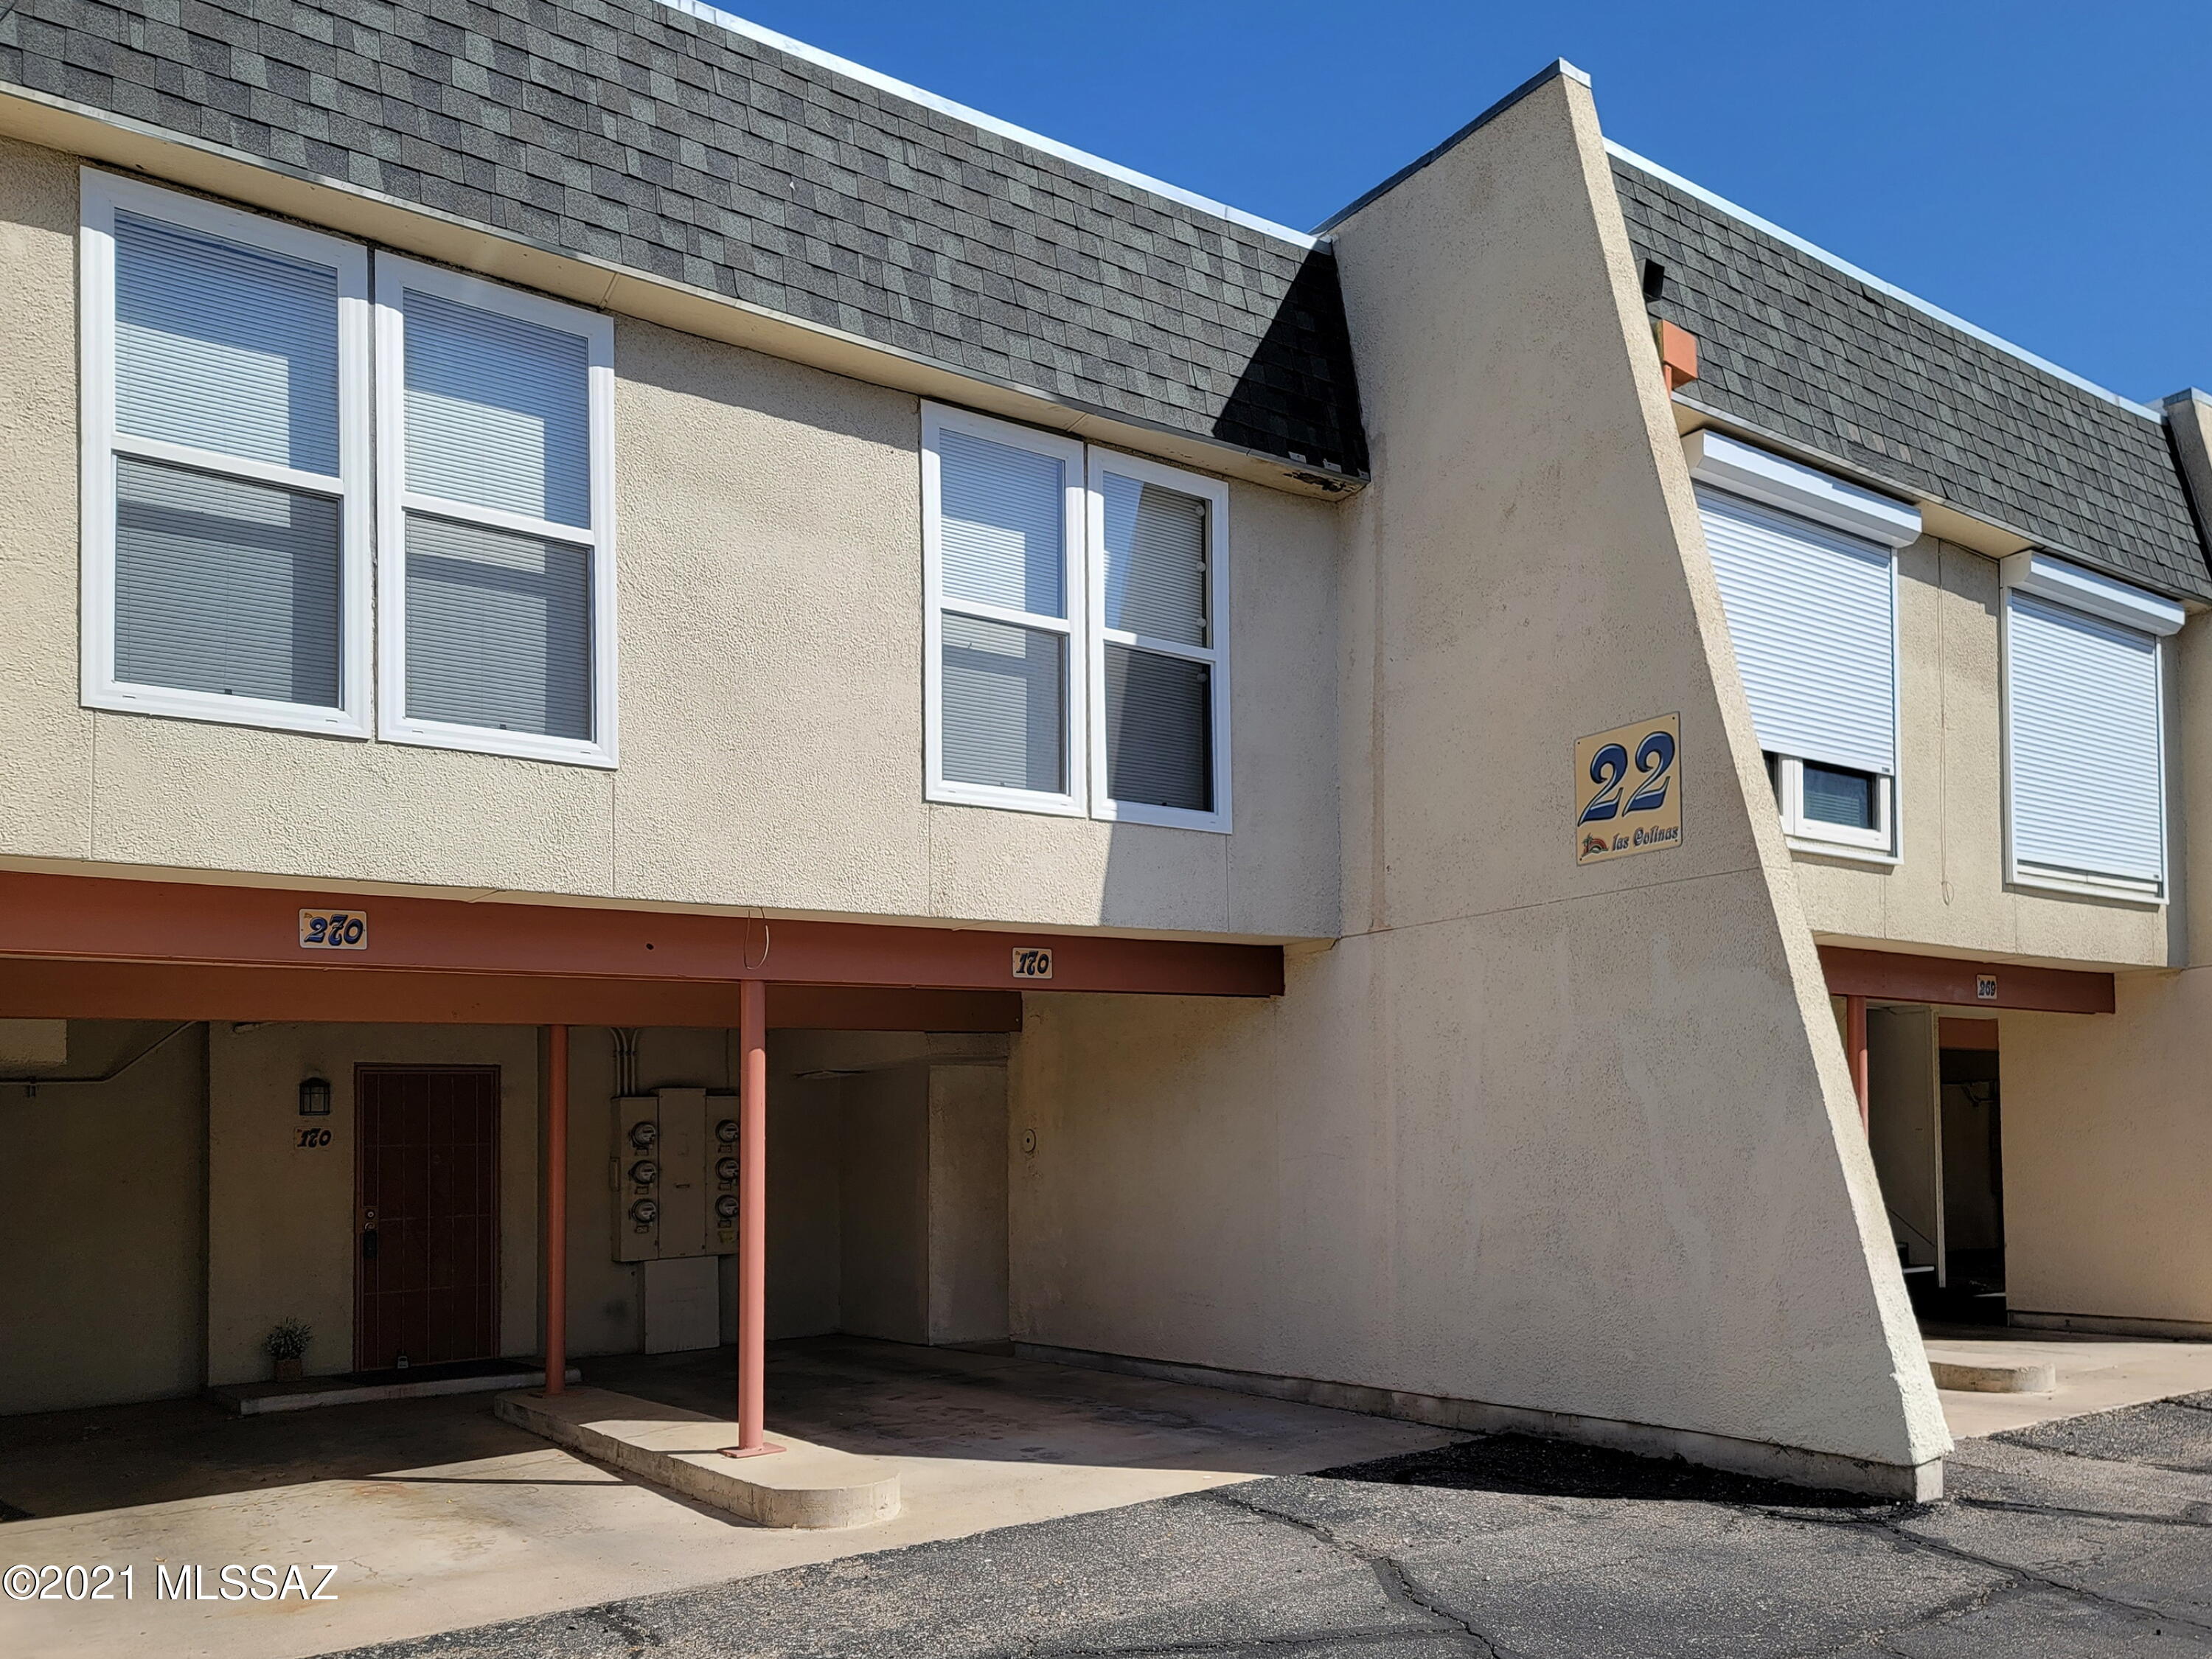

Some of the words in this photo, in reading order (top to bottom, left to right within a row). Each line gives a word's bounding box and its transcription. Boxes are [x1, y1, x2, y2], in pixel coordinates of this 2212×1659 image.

[1577, 731, 1675, 827] 22
[304, 914, 364, 946] 270
[1016, 950, 1049, 975] 170
[1978, 980, 1996, 996] 269
[296, 1127, 332, 1148] 170
